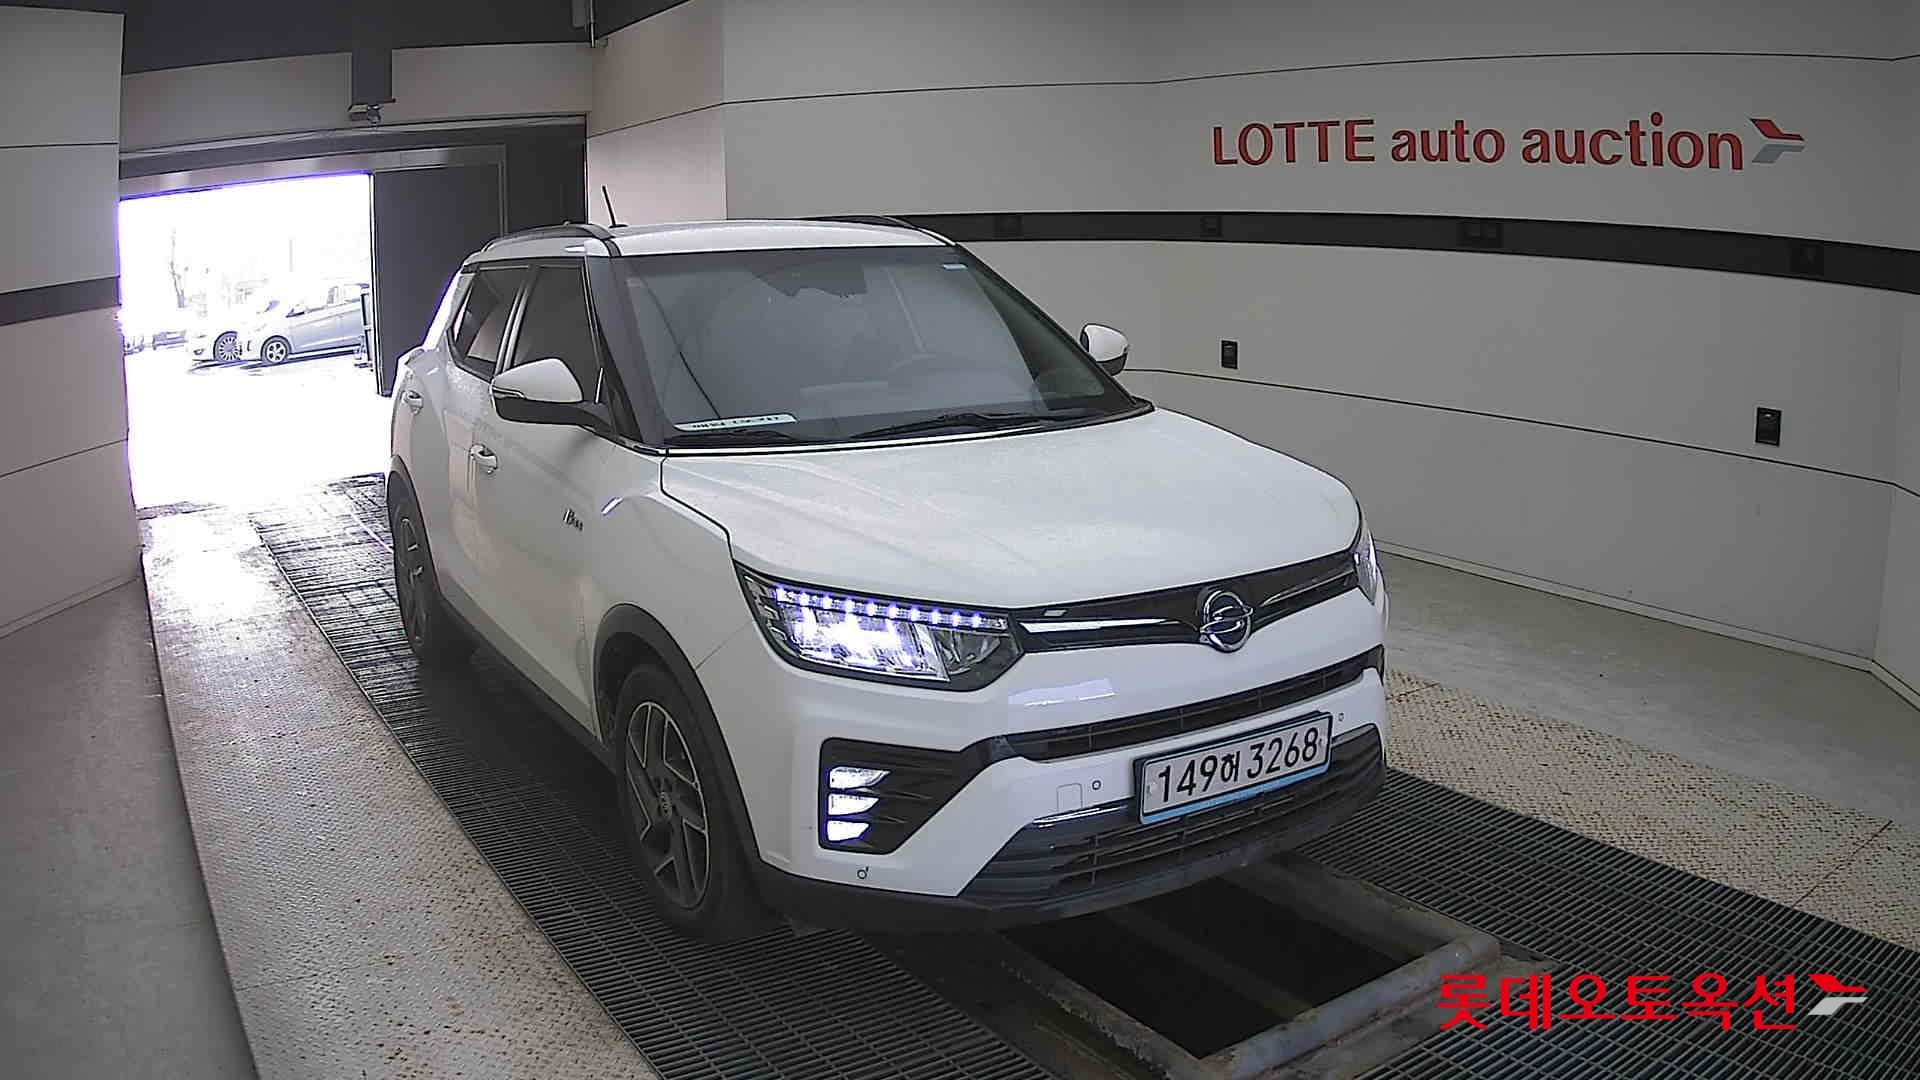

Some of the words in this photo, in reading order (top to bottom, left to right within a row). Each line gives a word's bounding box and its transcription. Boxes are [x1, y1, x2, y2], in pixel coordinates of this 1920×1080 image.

[1212, 119, 1376, 166] LOTTE
[1391, 119, 1505, 163] auto
[1522, 112, 1744, 171] auction
[1247, 727, 1319, 778] 3268
